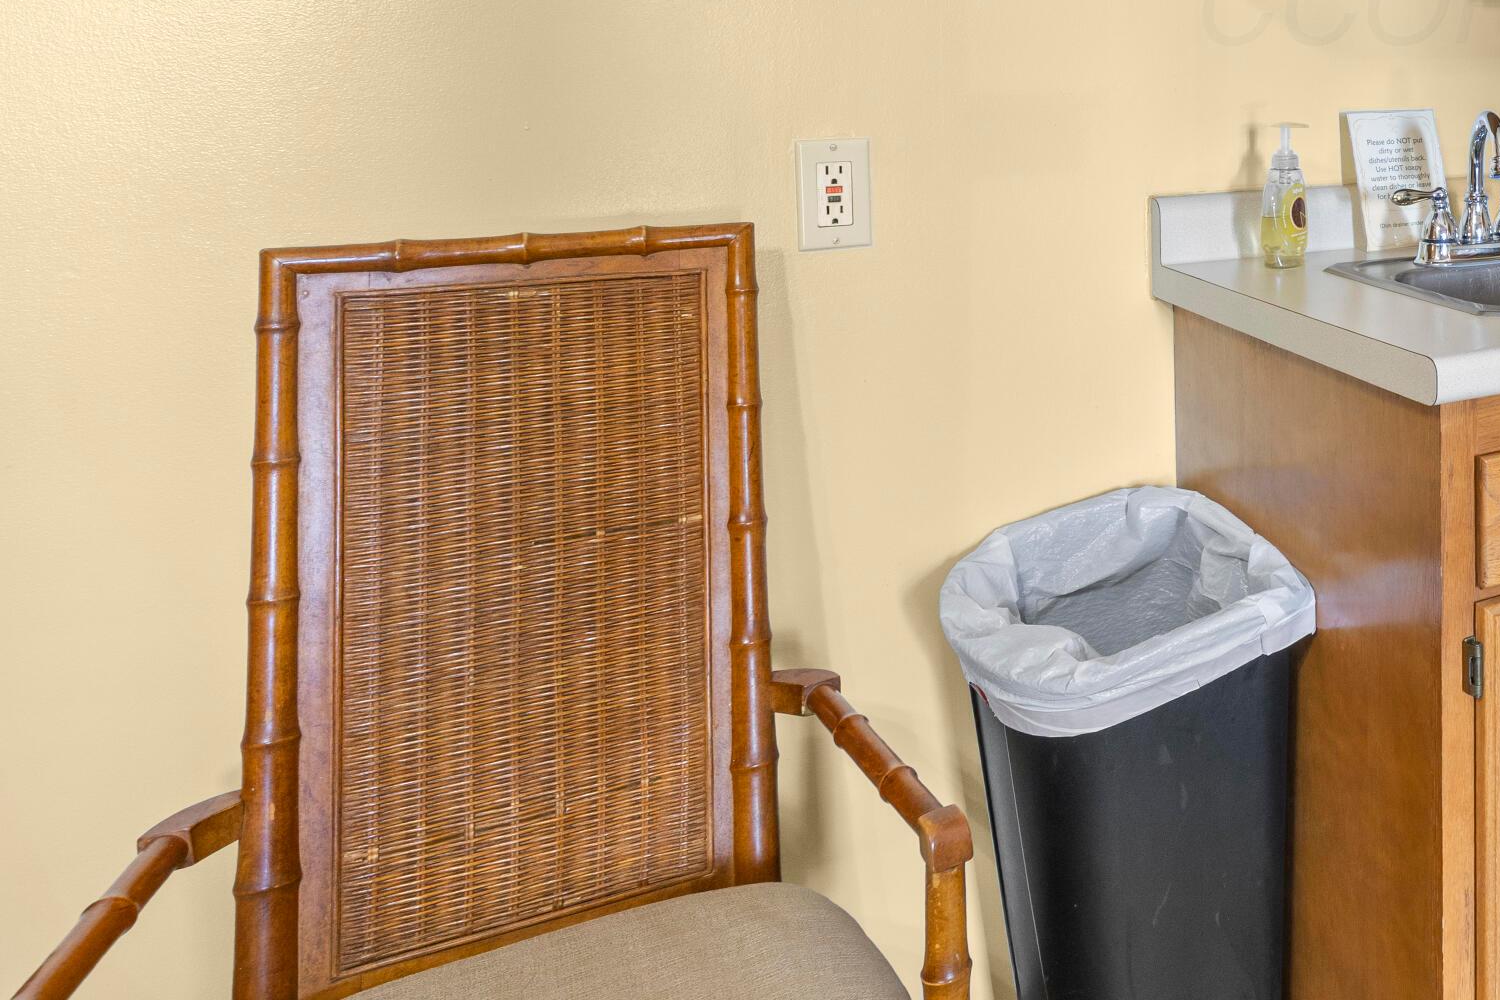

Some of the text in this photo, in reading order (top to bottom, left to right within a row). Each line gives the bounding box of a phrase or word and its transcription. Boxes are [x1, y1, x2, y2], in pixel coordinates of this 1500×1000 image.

[1366, 138, 1385, 146] Please
[1413, 137, 1423, 145] put
[1388, 164, 1403, 172] HOT
[1398, 172, 1430, 181] thoroughly
